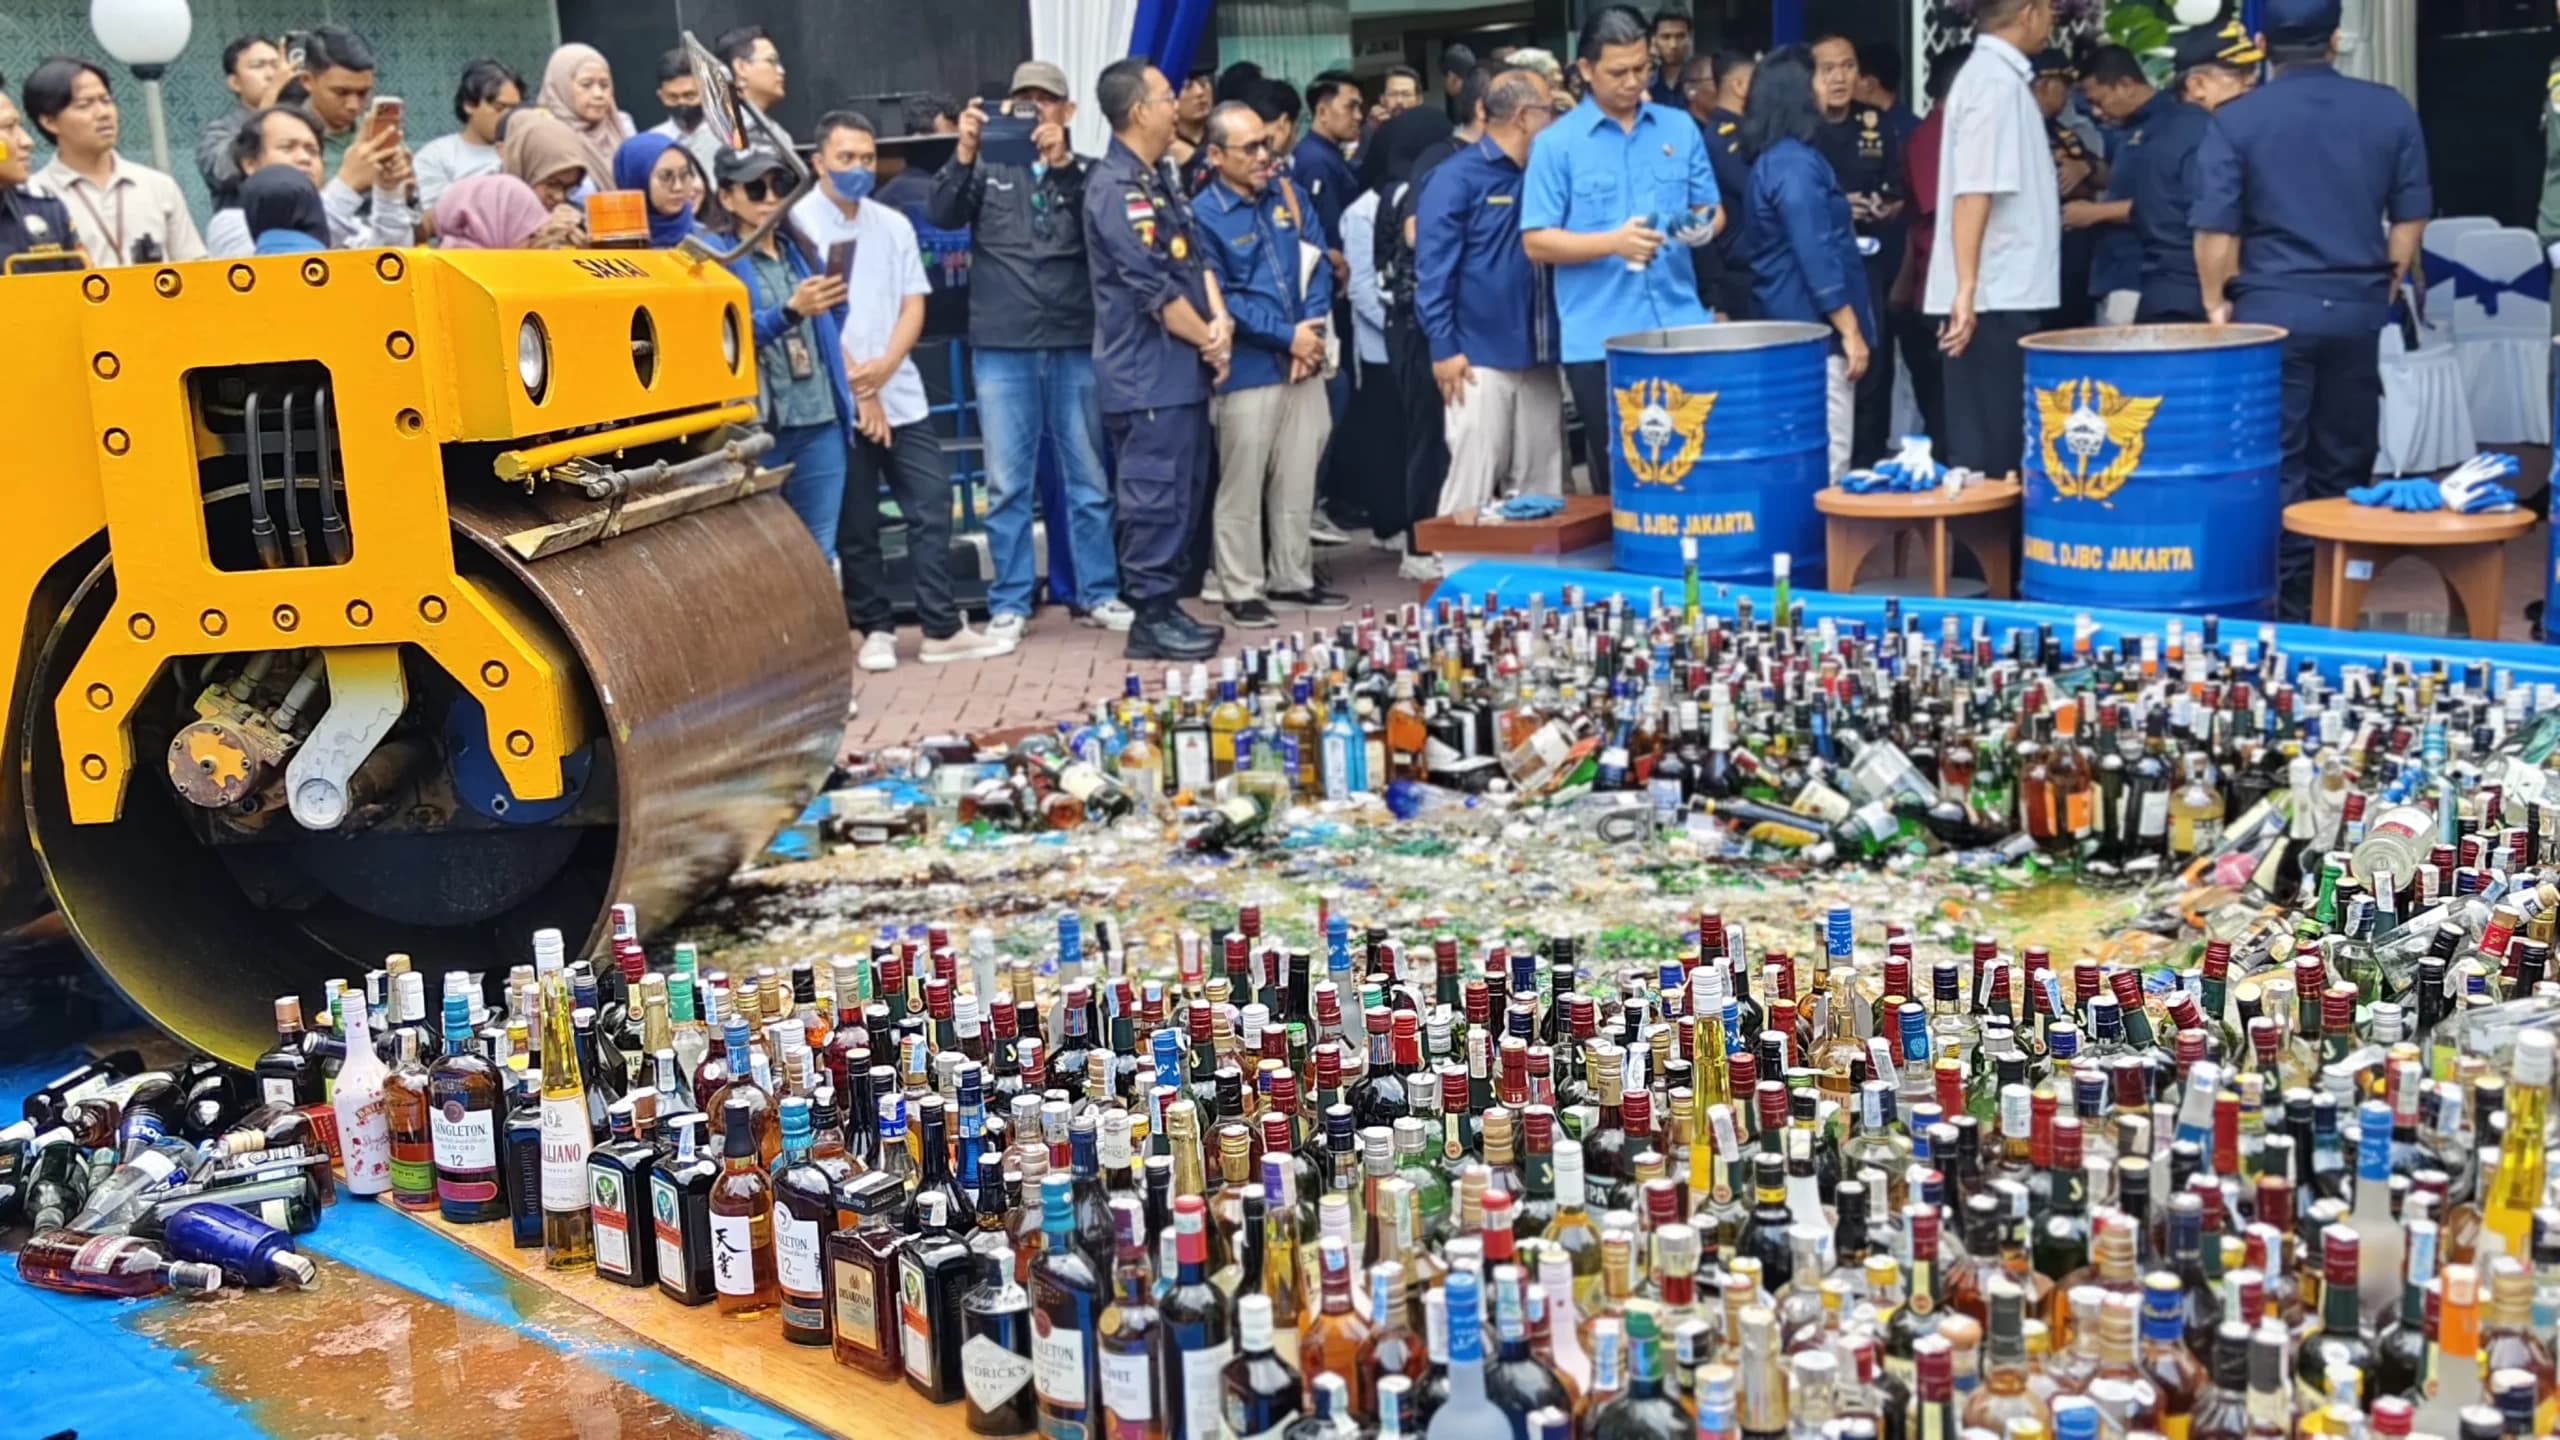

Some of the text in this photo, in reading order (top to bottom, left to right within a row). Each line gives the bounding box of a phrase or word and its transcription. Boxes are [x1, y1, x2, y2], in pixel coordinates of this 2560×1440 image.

[572, 258, 651, 278] SAKAI
[1682, 511, 1755, 537] JAKARTA
[2060, 542, 2103, 569] DJBC
[2107, 546, 2194, 571] JAKARTA
[1511, 1093, 1522, 1102] 12
[434, 1121, 487, 1137] SINGLETON
[450, 1154, 464, 1167] 12
[838, 1287, 872, 1308] DISARONNO
